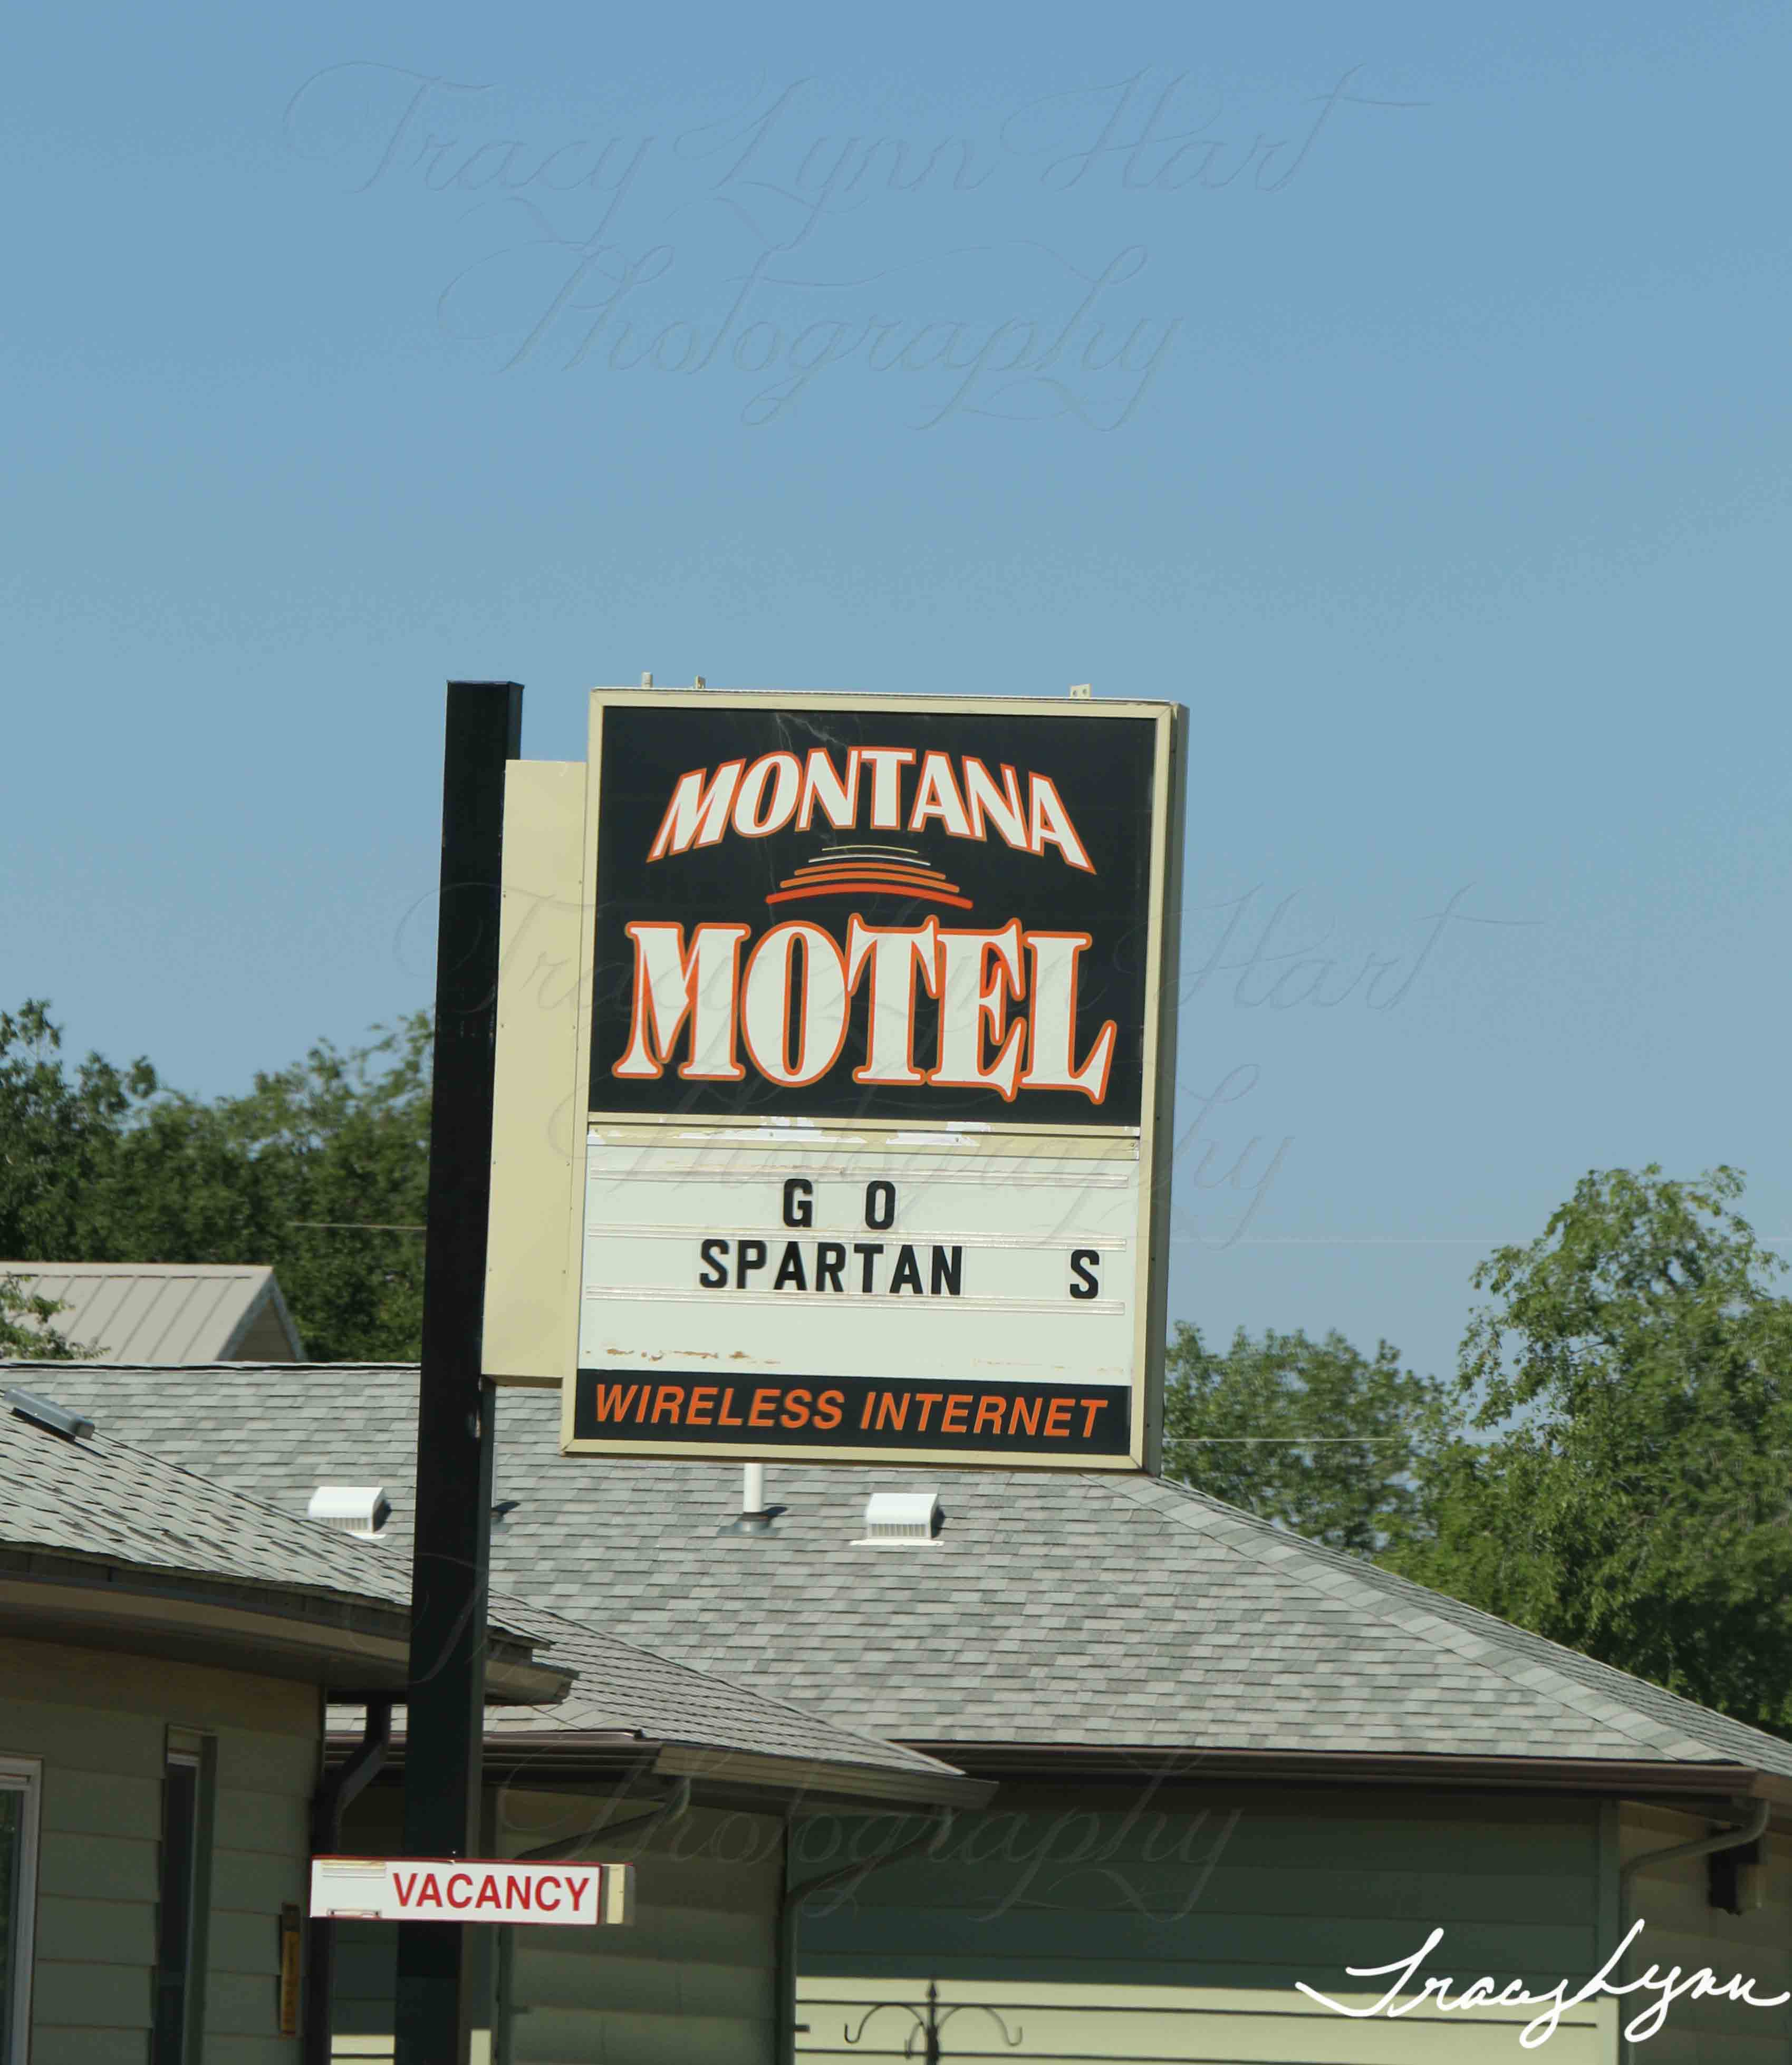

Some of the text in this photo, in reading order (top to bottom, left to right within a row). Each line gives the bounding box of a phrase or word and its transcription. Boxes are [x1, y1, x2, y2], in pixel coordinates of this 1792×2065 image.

[646, 746, 1096, 874] MONTANA
[612, 913, 1117, 1104] MOTEL
[700, 1239, 962, 1296] SPARTAN
[596, 1383, 1107, 1437] WIRELESS INTERNET
[393, 1873, 590, 1912] VACANCY
